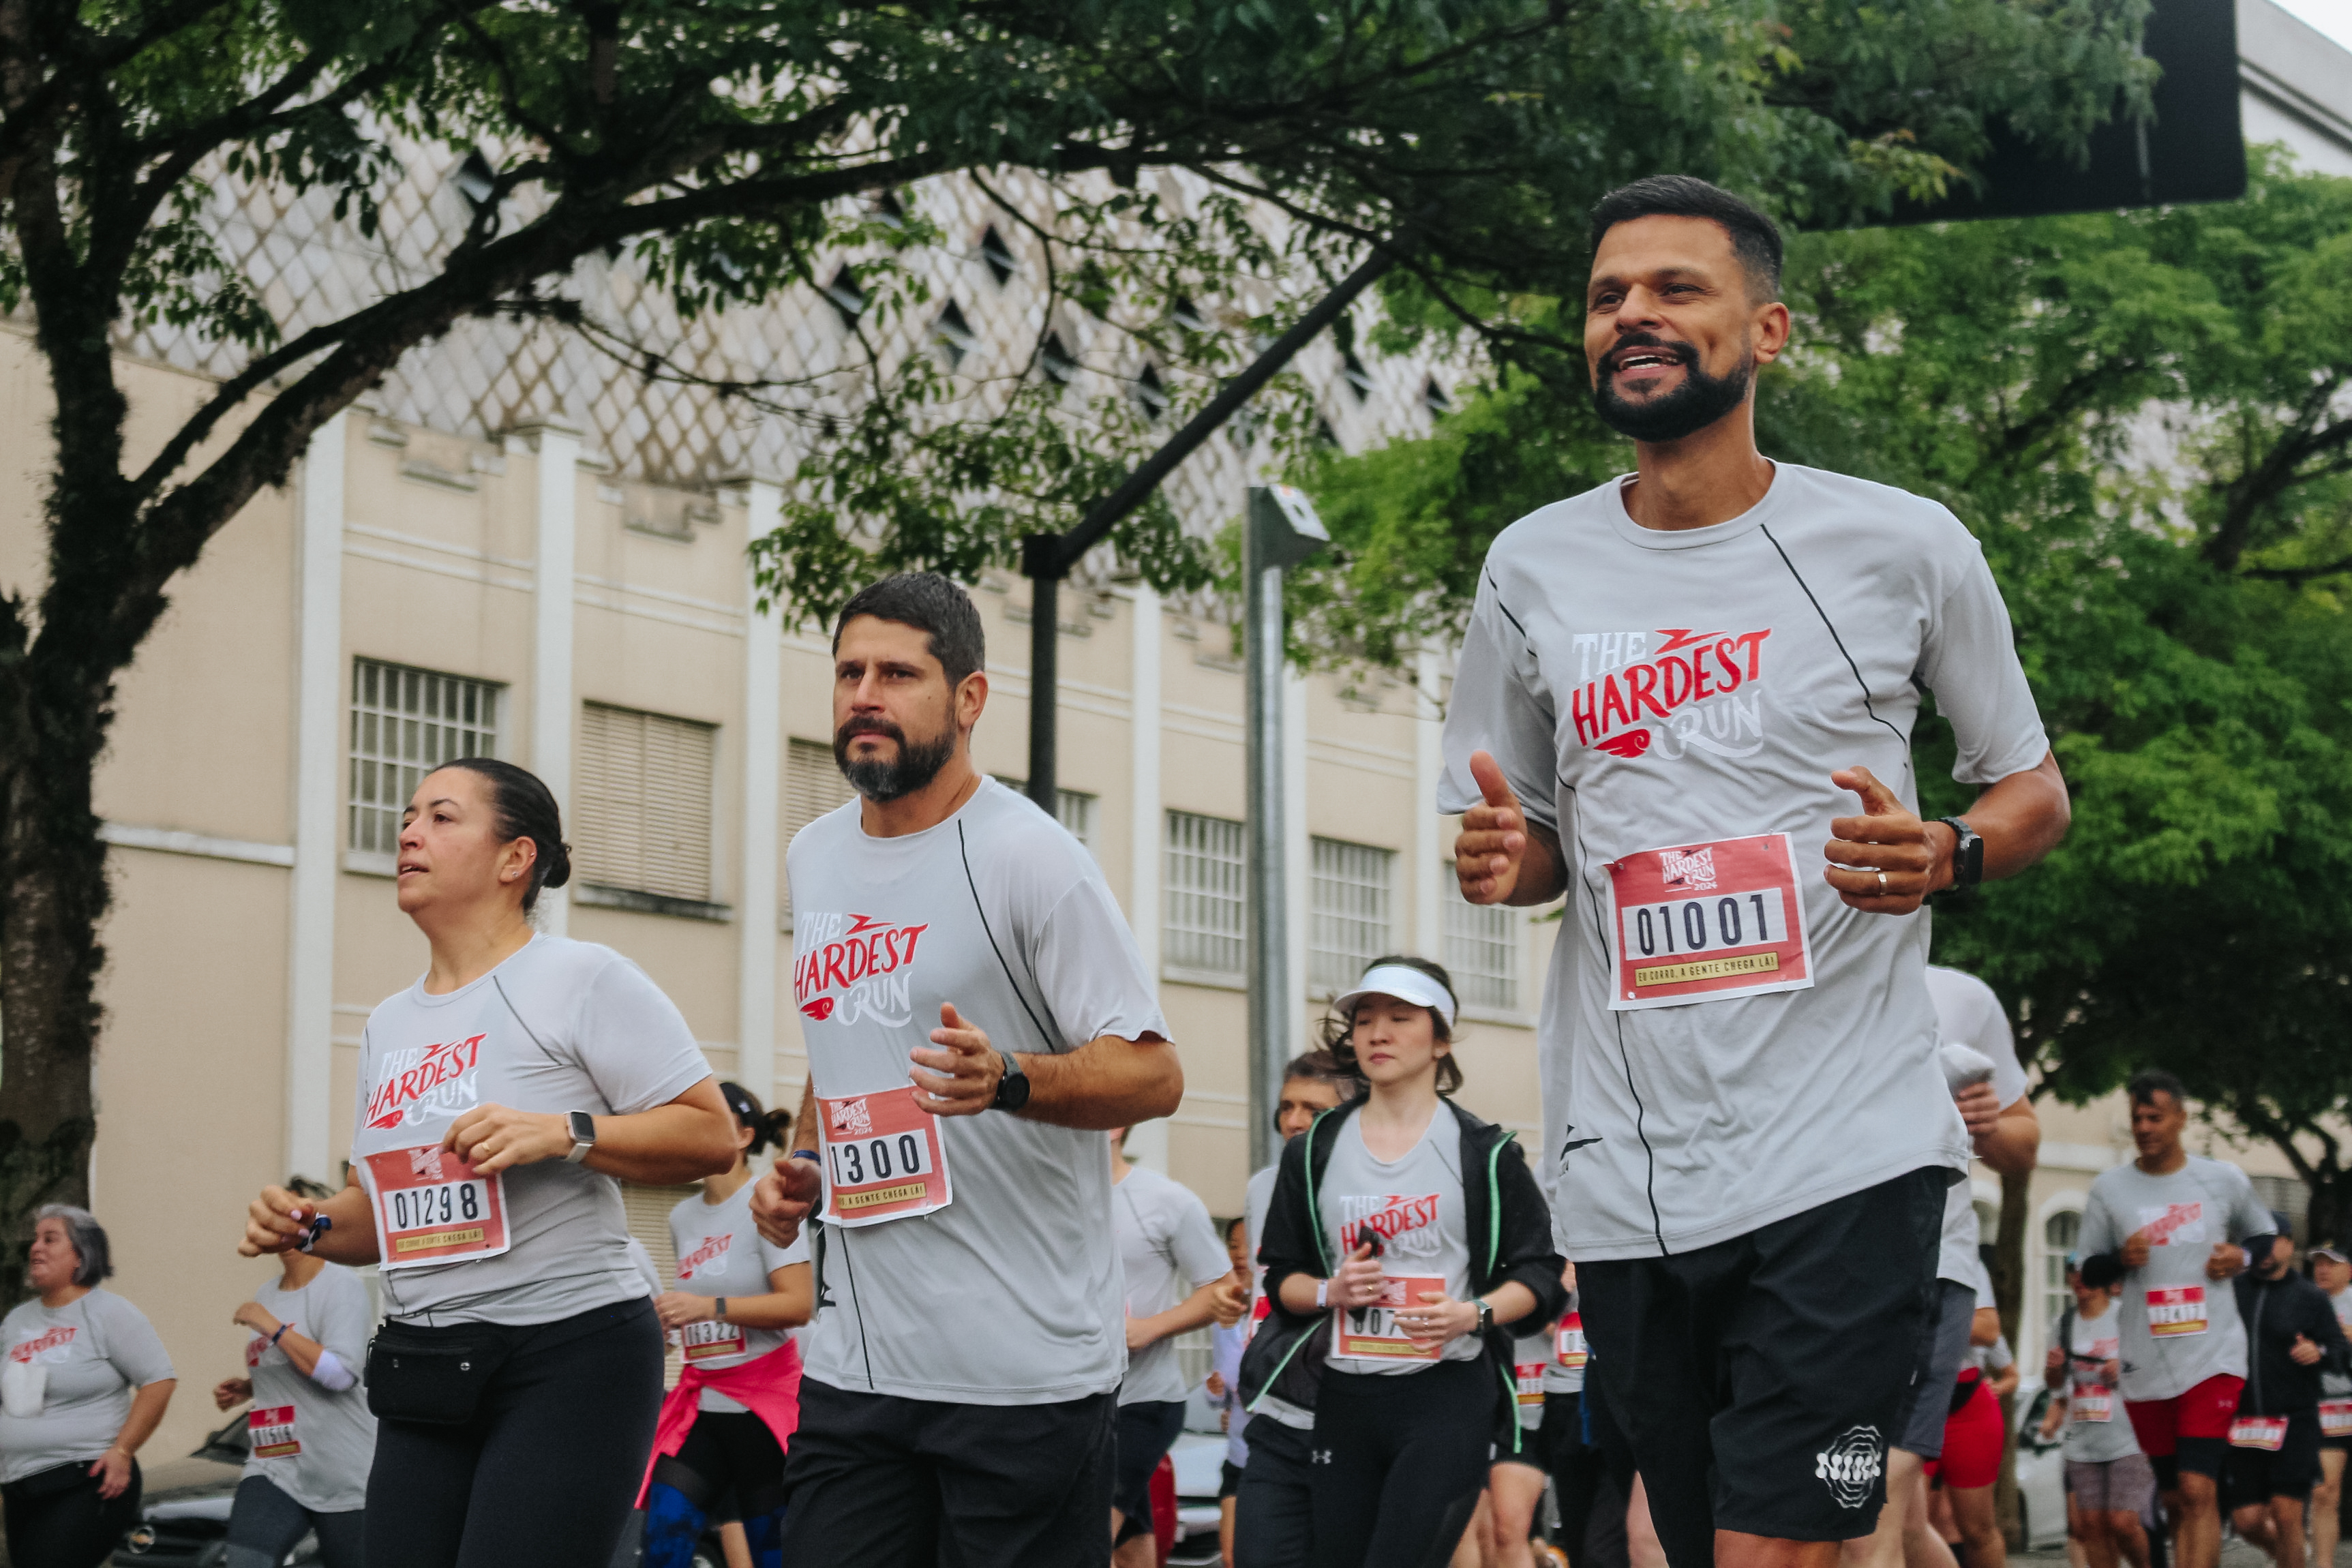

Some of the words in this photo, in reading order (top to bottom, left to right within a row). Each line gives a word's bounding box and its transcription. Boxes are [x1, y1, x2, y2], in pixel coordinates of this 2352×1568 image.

[1571, 631, 1647, 683] THE
[1571, 628, 1772, 747] HARDEST
[1652, 688, 1764, 760] RUN
[1659, 851, 1683, 866] THE
[1663, 847, 1713, 884] HARDEST
[1685, 862, 1717, 885] RUN
[799, 911, 842, 954] THE
[1638, 894, 1768, 955] 01001
[794, 922, 929, 1006] HARDEST
[1689, 963, 1720, 976] GENTE
[1724, 959, 1755, 971] CHEGA
[835, 971, 913, 1027] RUN
[362, 1032, 488, 1129] HARDEST
[379, 1048, 419, 1083] THE
[405, 1070, 480, 1126] RUN
[395, 1183, 479, 1228] 01298
[855, 1193, 881, 1205] GENTE
[883, 1188, 907, 1199] CHEGA
[1339, 1196, 1380, 1222] THE
[1384, 1226, 1443, 1258] RUN
